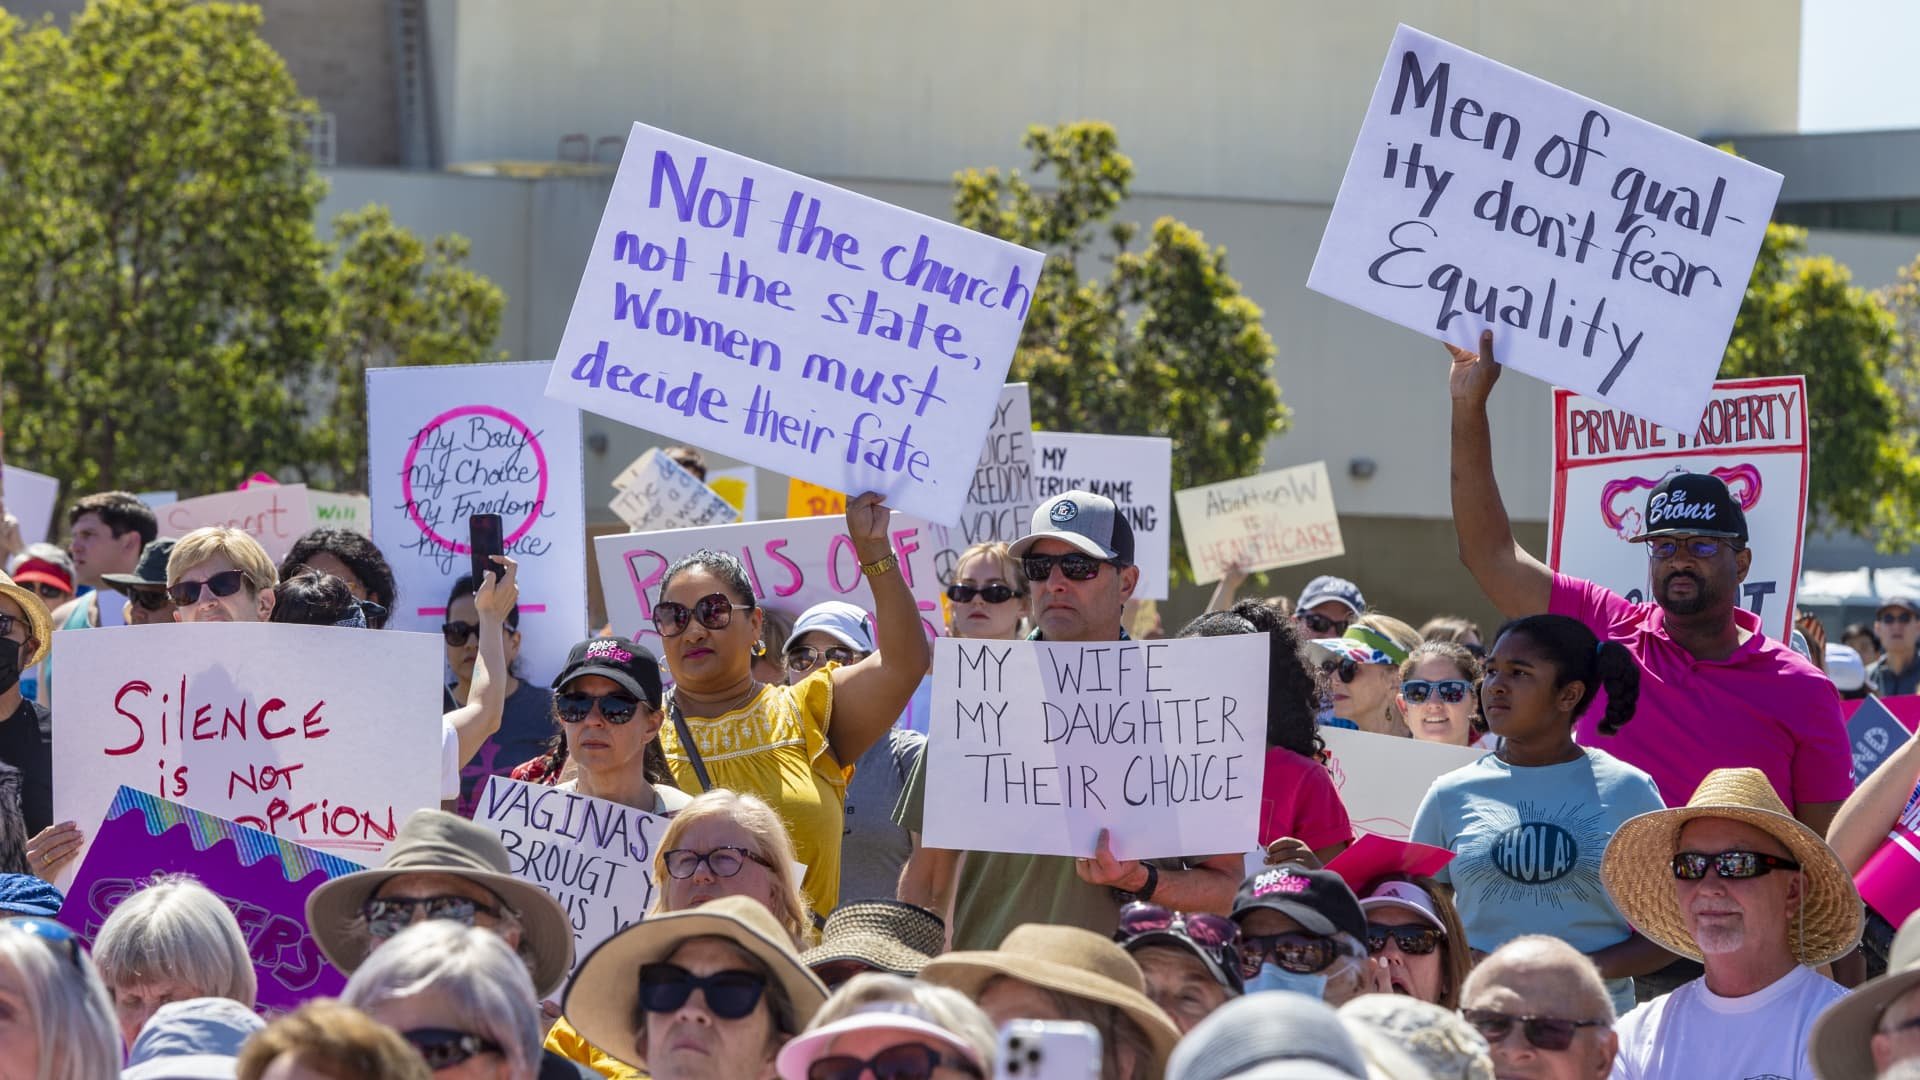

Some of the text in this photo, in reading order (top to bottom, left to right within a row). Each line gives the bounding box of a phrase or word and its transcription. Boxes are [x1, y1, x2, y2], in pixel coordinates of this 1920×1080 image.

[1390, 50, 1746, 237] Men of qual-
[649, 149, 1030, 321] Not the church
[1383, 142, 1723, 297] ity don't fear
[613, 230, 981, 370] not the state,
[1368, 220, 1644, 396] Equality
[614, 282, 781, 371] Women
[801, 352, 947, 417] must
[571, 341, 729, 424] decide
[742, 384, 836, 454] their
[844, 412, 938, 484] fate.
[408, 416, 544, 473] My Body
[1041, 448, 1068, 471] MY
[397, 458, 541, 499] My Choice
[1090, 480, 1133, 503] NAME
[1671, 489, 1688, 503] El
[394, 490, 556, 534] My Freedom
[1649, 492, 1717, 525] Bronx
[400, 537, 459, 575] My
[957, 643, 1013, 693] MY
[1047, 644, 1173, 696] WIFE
[955, 695, 1246, 747] MY DAUGHTER
[227, 763, 305, 801] NOT
[964, 752, 1244, 811] THEIR CHOICE
[487, 777, 654, 863] VAGINAS
[500, 829, 629, 899] BROUGT
